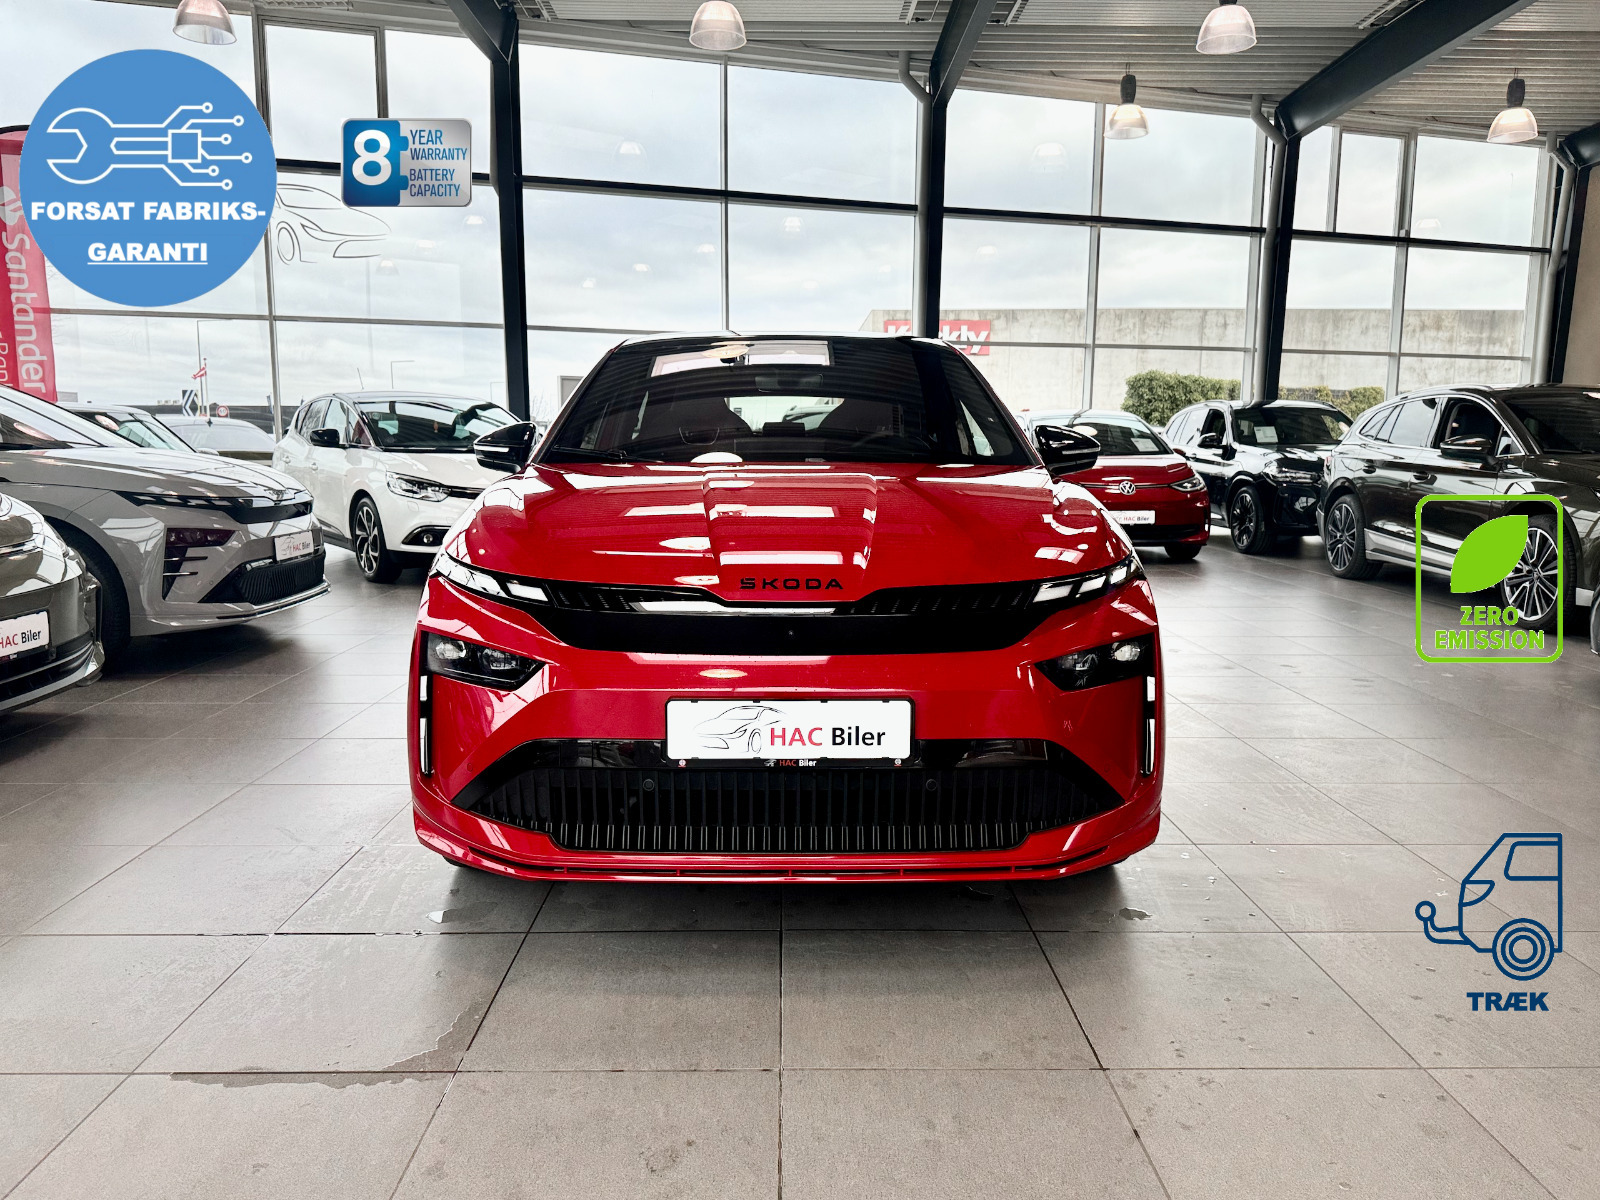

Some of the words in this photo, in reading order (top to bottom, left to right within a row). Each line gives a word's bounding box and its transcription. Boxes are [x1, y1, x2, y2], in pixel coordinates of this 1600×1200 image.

[2, 231, 48, 394] Santander
[20, 629, 42, 644] Biler
[770, 727, 824, 747] HAC
[831, 725, 886, 747] Biler
[779, 759, 797, 767] HAC
[798, 759, 817, 767] Biler
